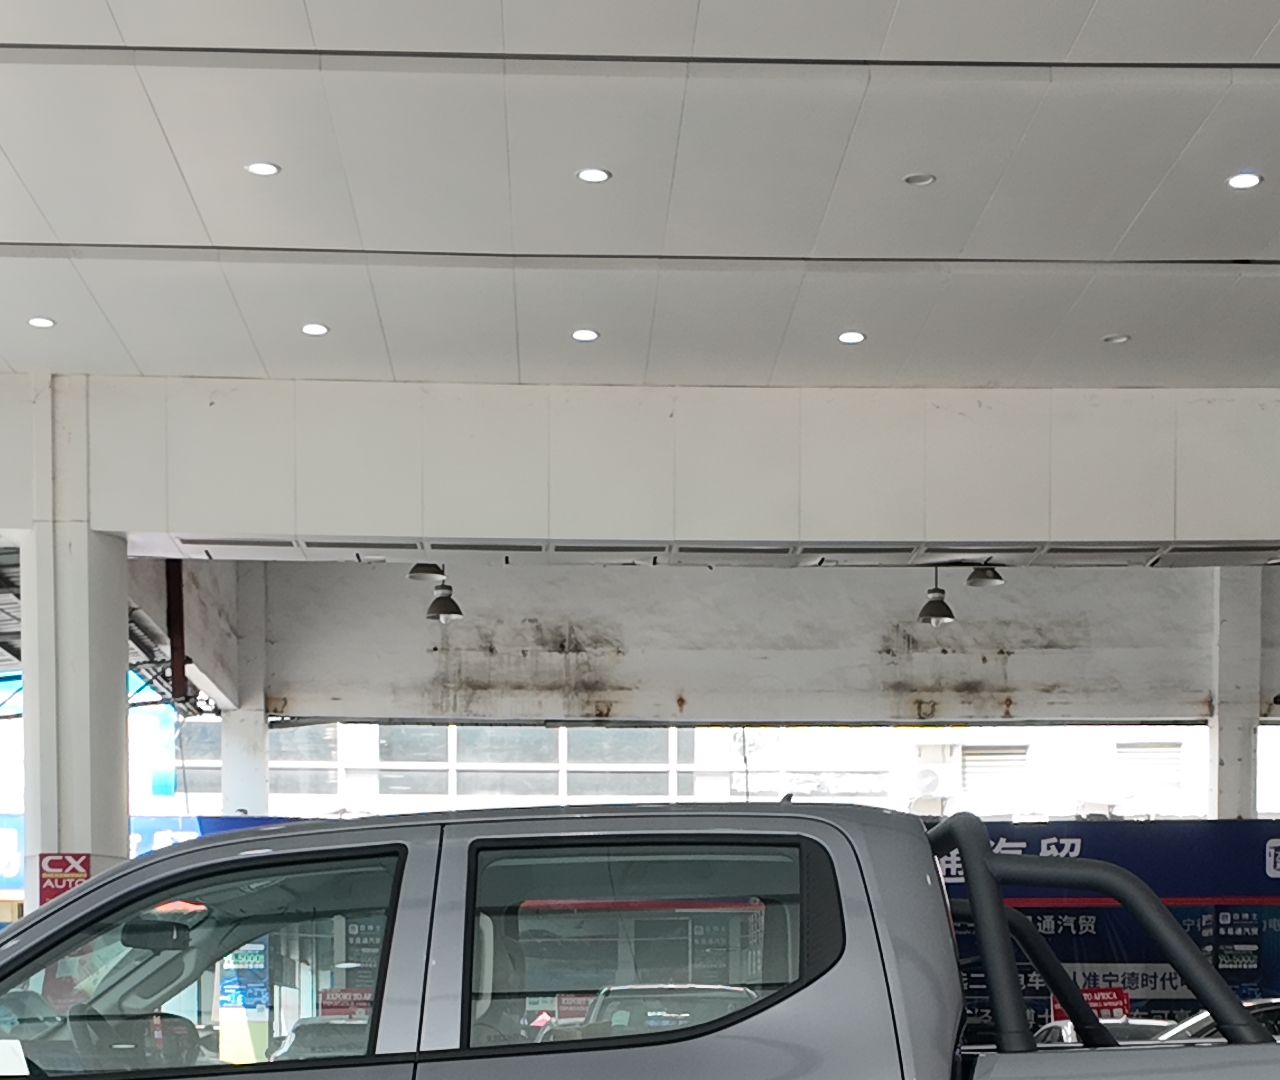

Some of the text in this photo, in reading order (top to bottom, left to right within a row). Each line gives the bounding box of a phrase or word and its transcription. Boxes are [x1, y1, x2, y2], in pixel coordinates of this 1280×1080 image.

[41, 855, 87, 873] CX
[1026, 914, 1097, 935] 通汽贸
[1072, 971, 1184, 991] 准宁德时代
